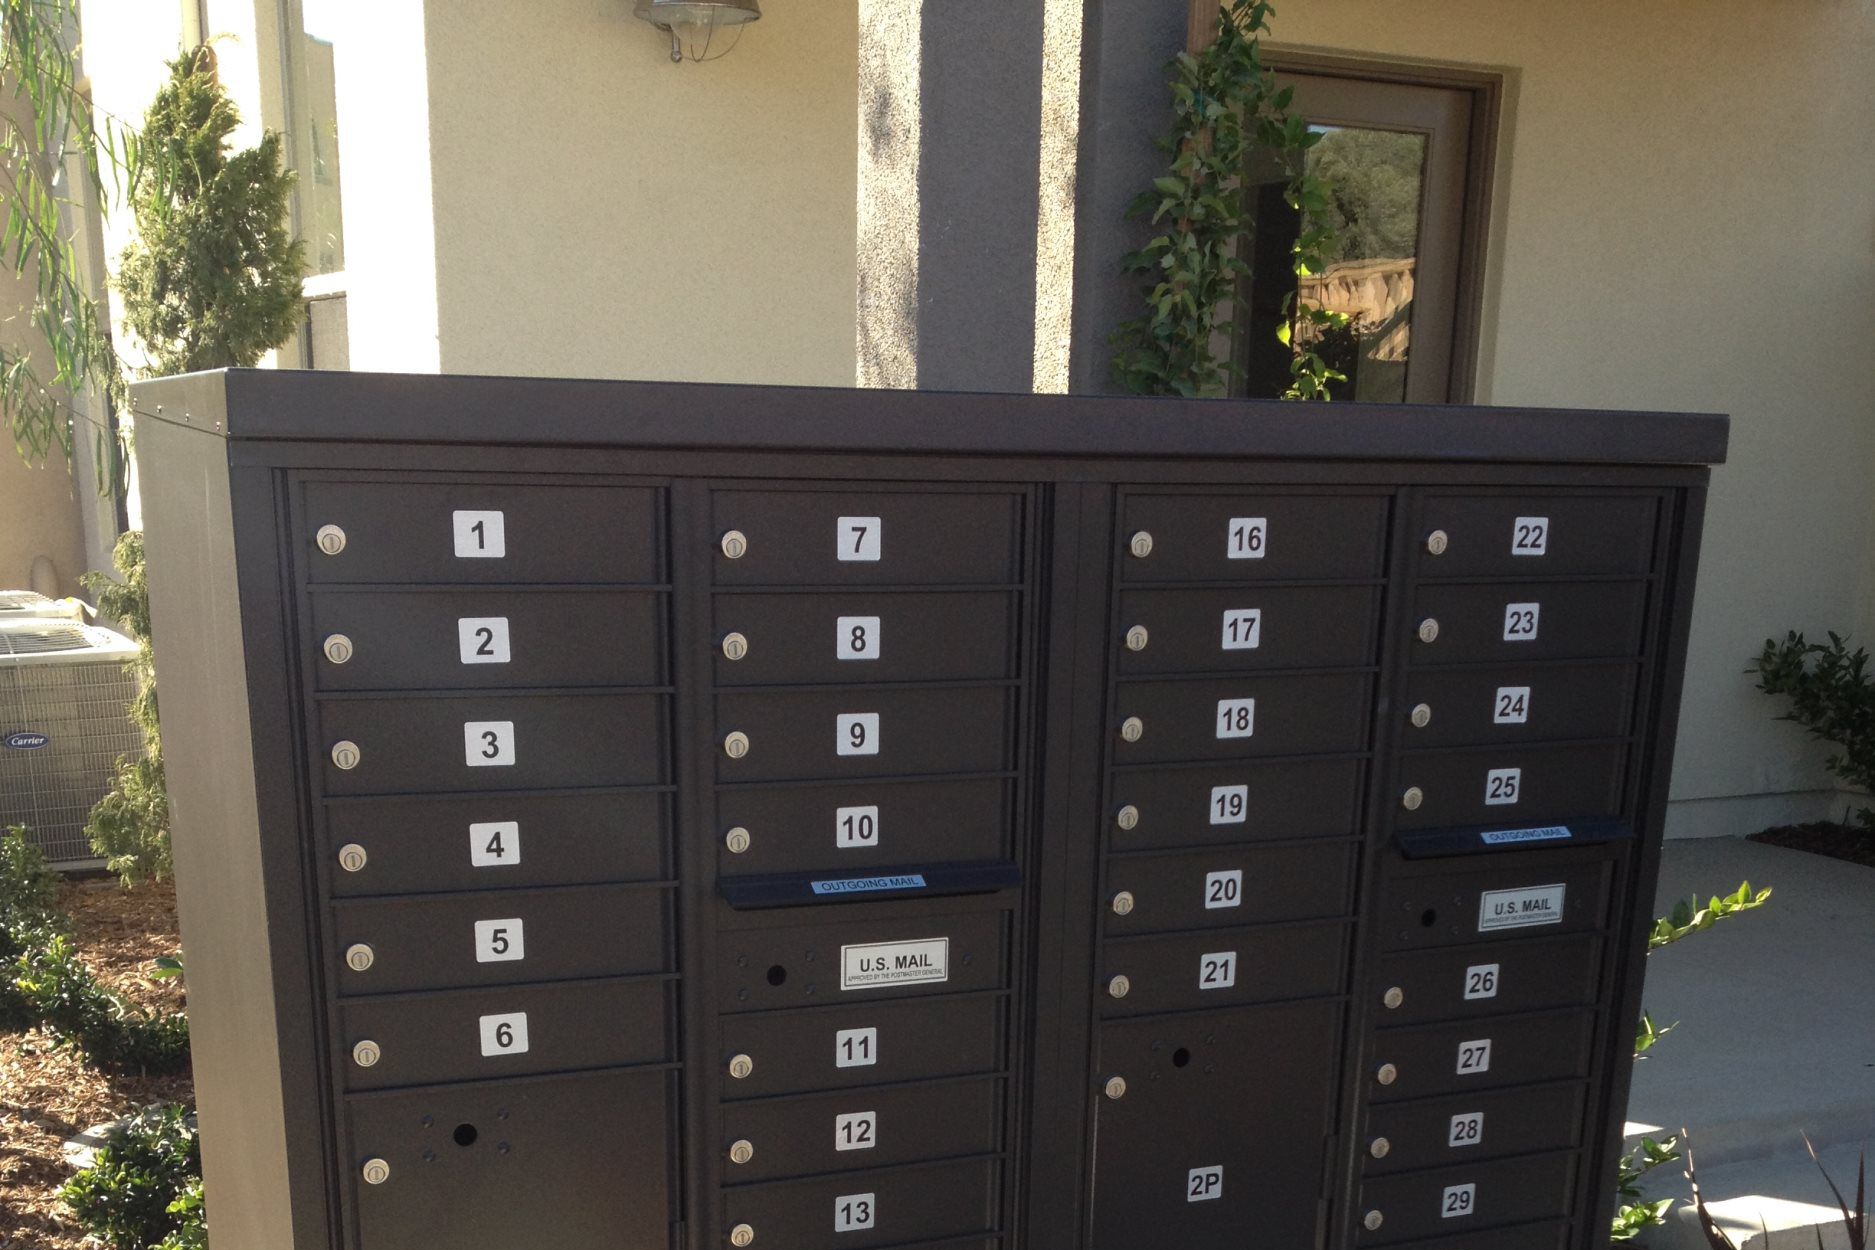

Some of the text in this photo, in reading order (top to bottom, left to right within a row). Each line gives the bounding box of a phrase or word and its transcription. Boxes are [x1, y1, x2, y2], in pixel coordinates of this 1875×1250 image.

[471, 520, 485, 550] 1
[851, 526, 868, 554] 7
[1234, 526, 1262, 552] 16
[1516, 524, 1544, 549] 22
[1228, 617, 1256, 643] 17
[1508, 610, 1534, 635] 23
[475, 627, 495, 656] 2
[850, 625, 867, 653] 8
[1498, 694, 1525, 718] 24
[1222, 706, 1250, 732] 18
[10, 737, 45, 746] Carrier
[481, 730, 500, 759] 3
[850, 722, 866, 749] 9
[1489, 775, 1516, 799] 25
[1216, 793, 1243, 818] 19
[842, 814, 874, 841] 10
[1488, 828, 1566, 841] OUTGOING MAIL
[485, 831, 505, 858] 4
[821, 877, 919, 891] OUTGOING MAIL
[1209, 878, 1238, 903] 20
[1494, 898, 1552, 916] U.S. MAIL
[491, 928, 509, 955] 5
[859, 953, 933, 973] U.S. MAIL
[1203, 959, 1229, 983] 21
[1468, 971, 1494, 994] 26
[495, 1022, 514, 1048] 6
[842, 1035, 869, 1061] 11
[1461, 1046, 1487, 1069] 27
[841, 1119, 871, 1144] 12
[1453, 1119, 1478, 1142] 28
[1190, 1172, 1220, 1197] 2P
[840, 1201, 870, 1225] 13
[1446, 1190, 1471, 1213] 29
